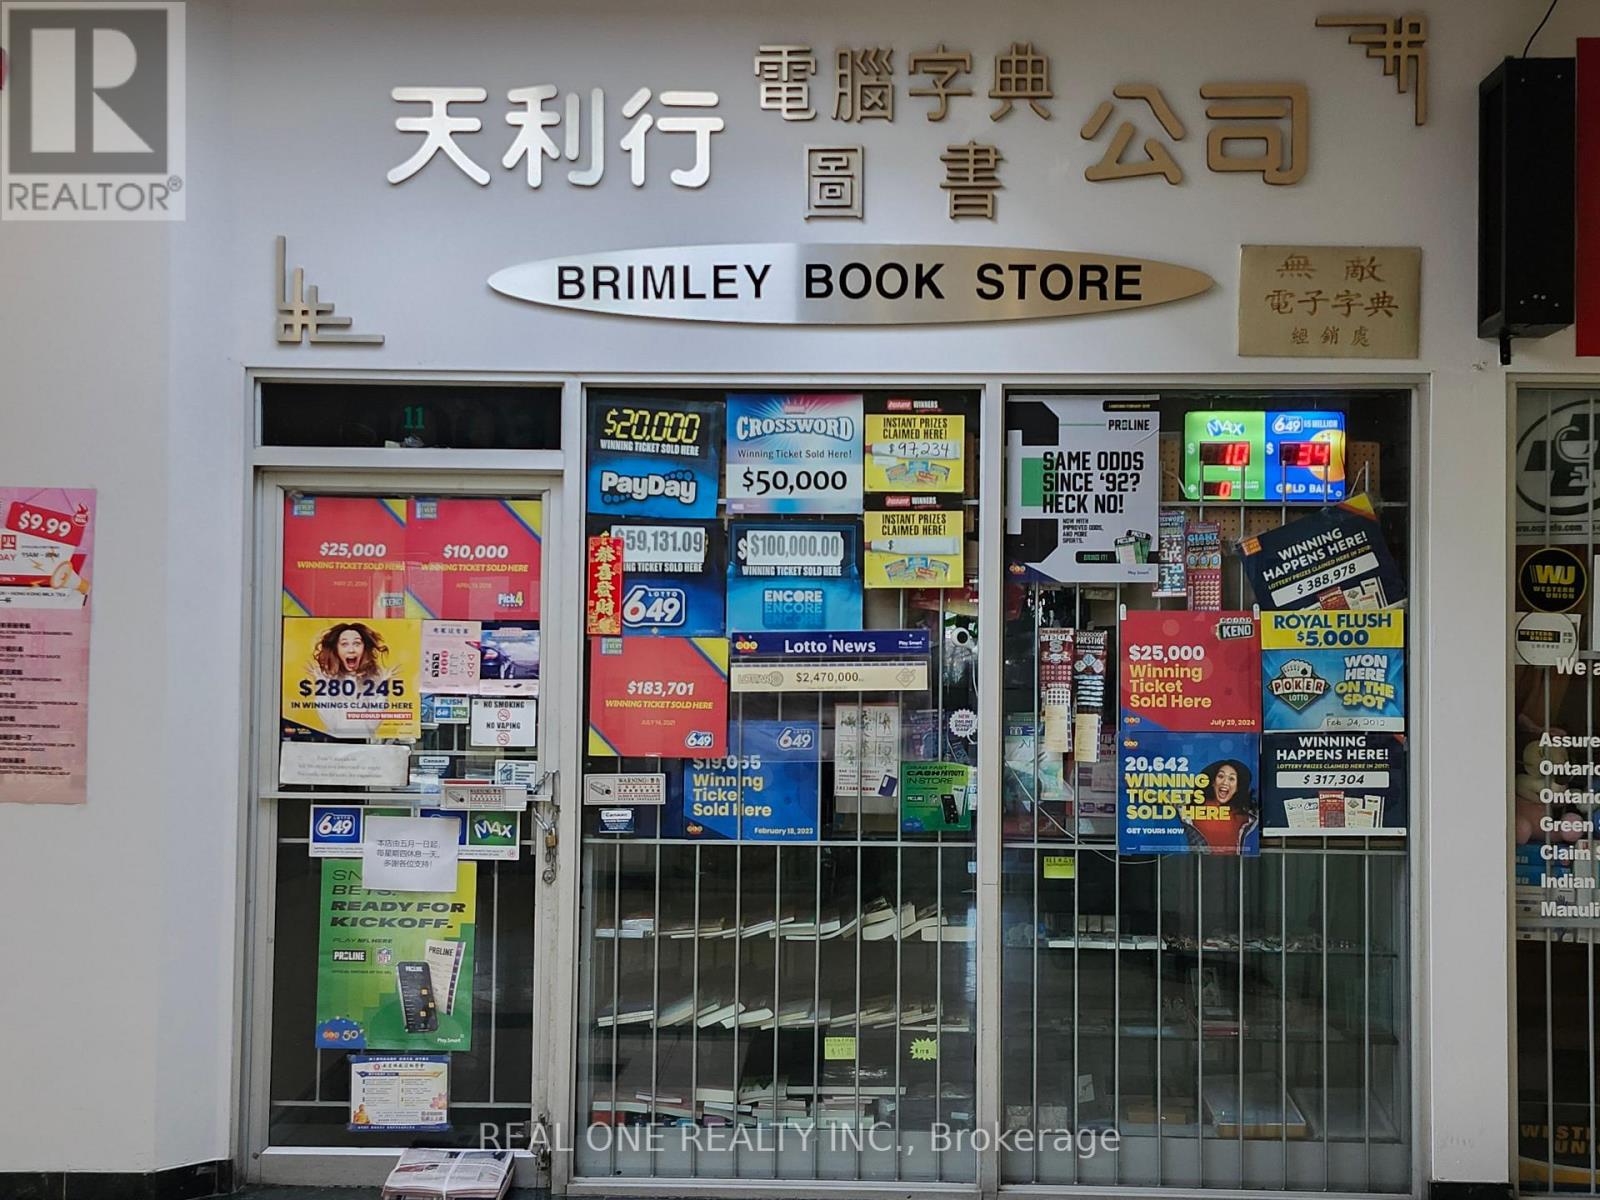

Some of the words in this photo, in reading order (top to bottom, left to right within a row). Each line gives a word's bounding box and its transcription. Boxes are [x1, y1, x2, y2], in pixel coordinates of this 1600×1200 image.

[753, 42, 1053, 124] 電腦字典
[387, 84, 724, 188] 天利行
[1080, 83, 1309, 186] 公司
[803, 140, 1005, 220] 圖書
[1276, 253, 1385, 282] 無敵
[556, 264, 772, 300] BRIMLEY
[804, 263, 944, 300] BOOK
[976, 263, 1143, 301] STORE
[1264, 290, 1400, 318] 電子字典
[404, 406, 425, 429] 11
[883, 418, 917, 428] INSTANT
[920, 418, 948, 428] PRIZES
[1274, 416, 1301, 432] 649
[604, 408, 700, 444] $20,000
[737, 416, 854, 441] CROSSWORD
[883, 429, 920, 439] CLAIMED
[924, 429, 947, 439] HERE!
[1206, 419, 1245, 436] MAX
[600, 439, 634, 451] WINNING
[635, 441, 660, 453] TICKET
[660, 444, 680, 455] SOLD
[681, 446, 700, 456] HERE
[738, 450, 774, 460] Winning
[776, 450, 802, 459] Ticket
[805, 449, 825, 459] Sold
[828, 449, 852, 459] Here!
[898, 442, 948, 457] 97,234
[1225, 444, 1249, 464] 10
[1266, 443, 1274, 455] $
[1297, 443, 1329, 465] 34
[1043, 451, 1091, 471] SAME
[1097, 451, 1144, 471] ODDS
[601, 471, 696, 504] PayDay
[742, 467, 847, 495] $50,000
[1043, 473, 1094, 492] SINCE
[1276, 484, 1305, 493] GOLD
[1043, 494, 1088, 514] HECK
[1094, 494, 1124, 514] NO!
[18, 510, 71, 537] $9.99
[882, 514, 915, 524] INSTANT
[919, 514, 946, 524] PRIZES
[882, 525, 919, 535] CLAIMED
[923, 525, 946, 535] HERE!
[320, 542, 386, 558] $25,000
[443, 544, 508, 560] $10,000
[750, 534, 839, 558] $100,000.00
[1278, 528, 1342, 561] WINNING
[1263, 547, 1326, 582] HAPPENS
[1328, 531, 1368, 556] HERE!
[298, 561, 334, 569] WINNING
[336, 561, 363, 569] TICKET
[363, 562, 385, 570] SOLD
[421, 563, 458, 571] WINNING
[486, 564, 507, 572] SOLD
[508, 564, 528, 572] HERE
[638, 562, 663, 572] TICKET
[664, 563, 683, 572] SOLD
[684, 563, 703, 573] HERE
[742, 566, 775, 576] WINNING
[776, 566, 802, 576] TICKET
[803, 566, 822, 576] SOLD
[823, 567, 842, 576] HERE
[1297, 583, 1304, 595] $
[1307, 563, 1357, 591] 388,978
[1536, 565, 1575, 584] WU
[764, 590, 823, 602] ENCORE
[623, 590, 680, 622] 649
[1274, 614, 1332, 629] ROYAL
[1337, 613, 1391, 628] FLUSH
[1222, 625, 1251, 637] KENO
[1297, 630, 1369, 646] $5,000
[785, 640, 826, 653] Lotto
[833, 640, 876, 653] News
[1129, 645, 1205, 663] $25,000
[1344, 654, 1387, 668] WON
[1556, 658, 1586, 675] We
[1130, 664, 1202, 682] Winning
[1345, 667, 1386, 681] HERE
[299, 679, 404, 699] $280,245
[627, 681, 695, 697] $183,701
[1130, 679, 1183, 693] Ticket
[1272, 678, 1326, 693] POKER
[1335, 680, 1361, 694] ON
[1364, 681, 1394, 698] THE
[605, 700, 642, 708] WINNING
[1130, 694, 1167, 708] Sold
[1171, 695, 1212, 708] Here
[1343, 693, 1386, 710] SPOT
[687, 732, 712, 747] 649
[779, 729, 812, 748] 649
[1299, 736, 1366, 747] WINNING
[1539, 733, 1600, 747] Assure
[1276, 749, 1342, 760] HAPPENS
[1347, 749, 1388, 760] HERE!
[1125, 757, 1189, 772] 20,642
[693, 773, 764, 791] Winnng
[1125, 774, 1210, 788] WINNING
[1303, 774, 1310, 785] $
[1313, 774, 1364, 786] 317,304
[693, 788, 744, 801] Ticke
[1127, 789, 1206, 804] TICKETS
[693, 803, 729, 816] Sold
[1126, 805, 1176, 820] SOLD
[1182, 805, 1231, 821] HERE
[319, 815, 352, 834] 649
[474, 820, 512, 839] MAX
[754, 827, 786, 835] February
[1126, 827, 1141, 835] GET
[1142, 827, 1165, 835] YOURS
[1167, 827, 1185, 835] NOW
[1540, 817, 1593, 832] Green
[1540, 845, 1591, 860] Claim
[1541, 873, 1595, 888] Indian
[331, 901, 412, 913] READY
[415, 902, 466, 913] FOR
[1541, 901, 1600, 917] Manuli
[330, 917, 453, 928] KICKOFF.
